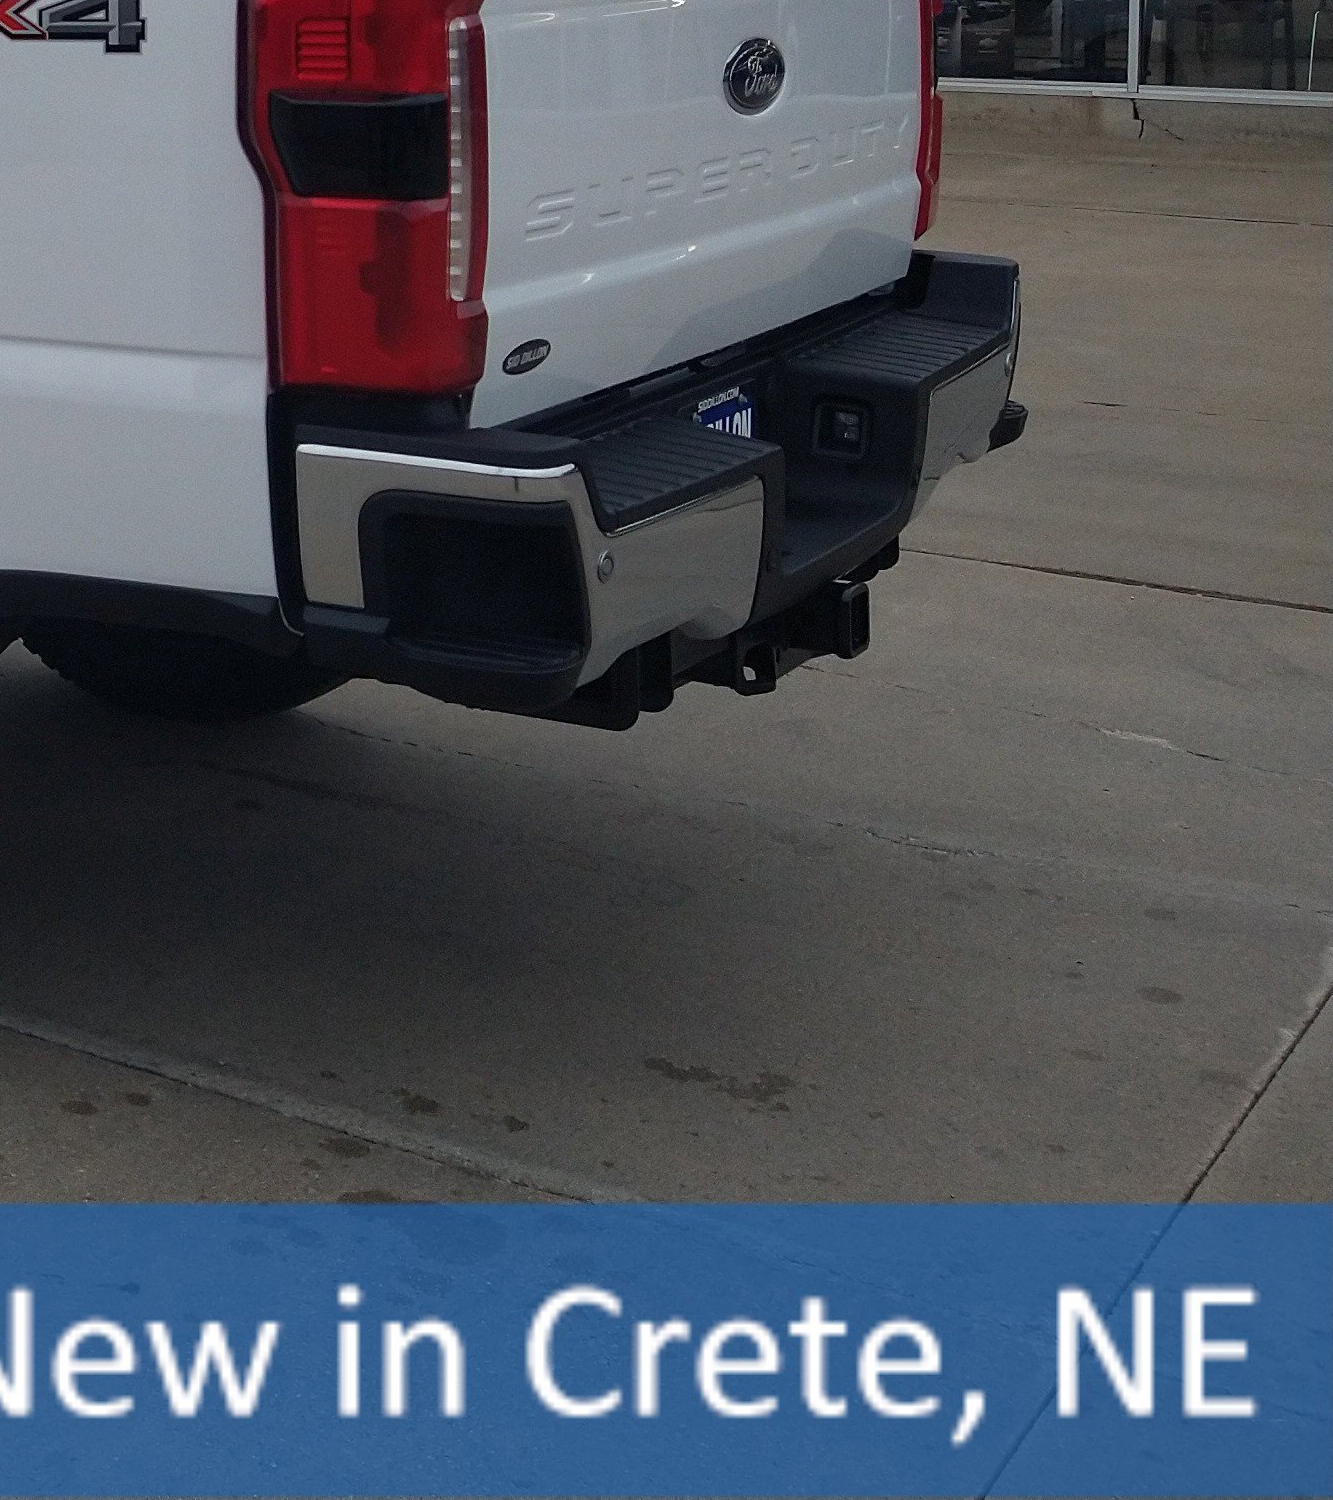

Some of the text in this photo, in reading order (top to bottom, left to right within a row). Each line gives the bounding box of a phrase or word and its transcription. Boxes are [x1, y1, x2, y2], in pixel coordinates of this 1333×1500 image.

[741, 51, 779, 98] Ford
[523, 112, 910, 242] SUPER DUTY
